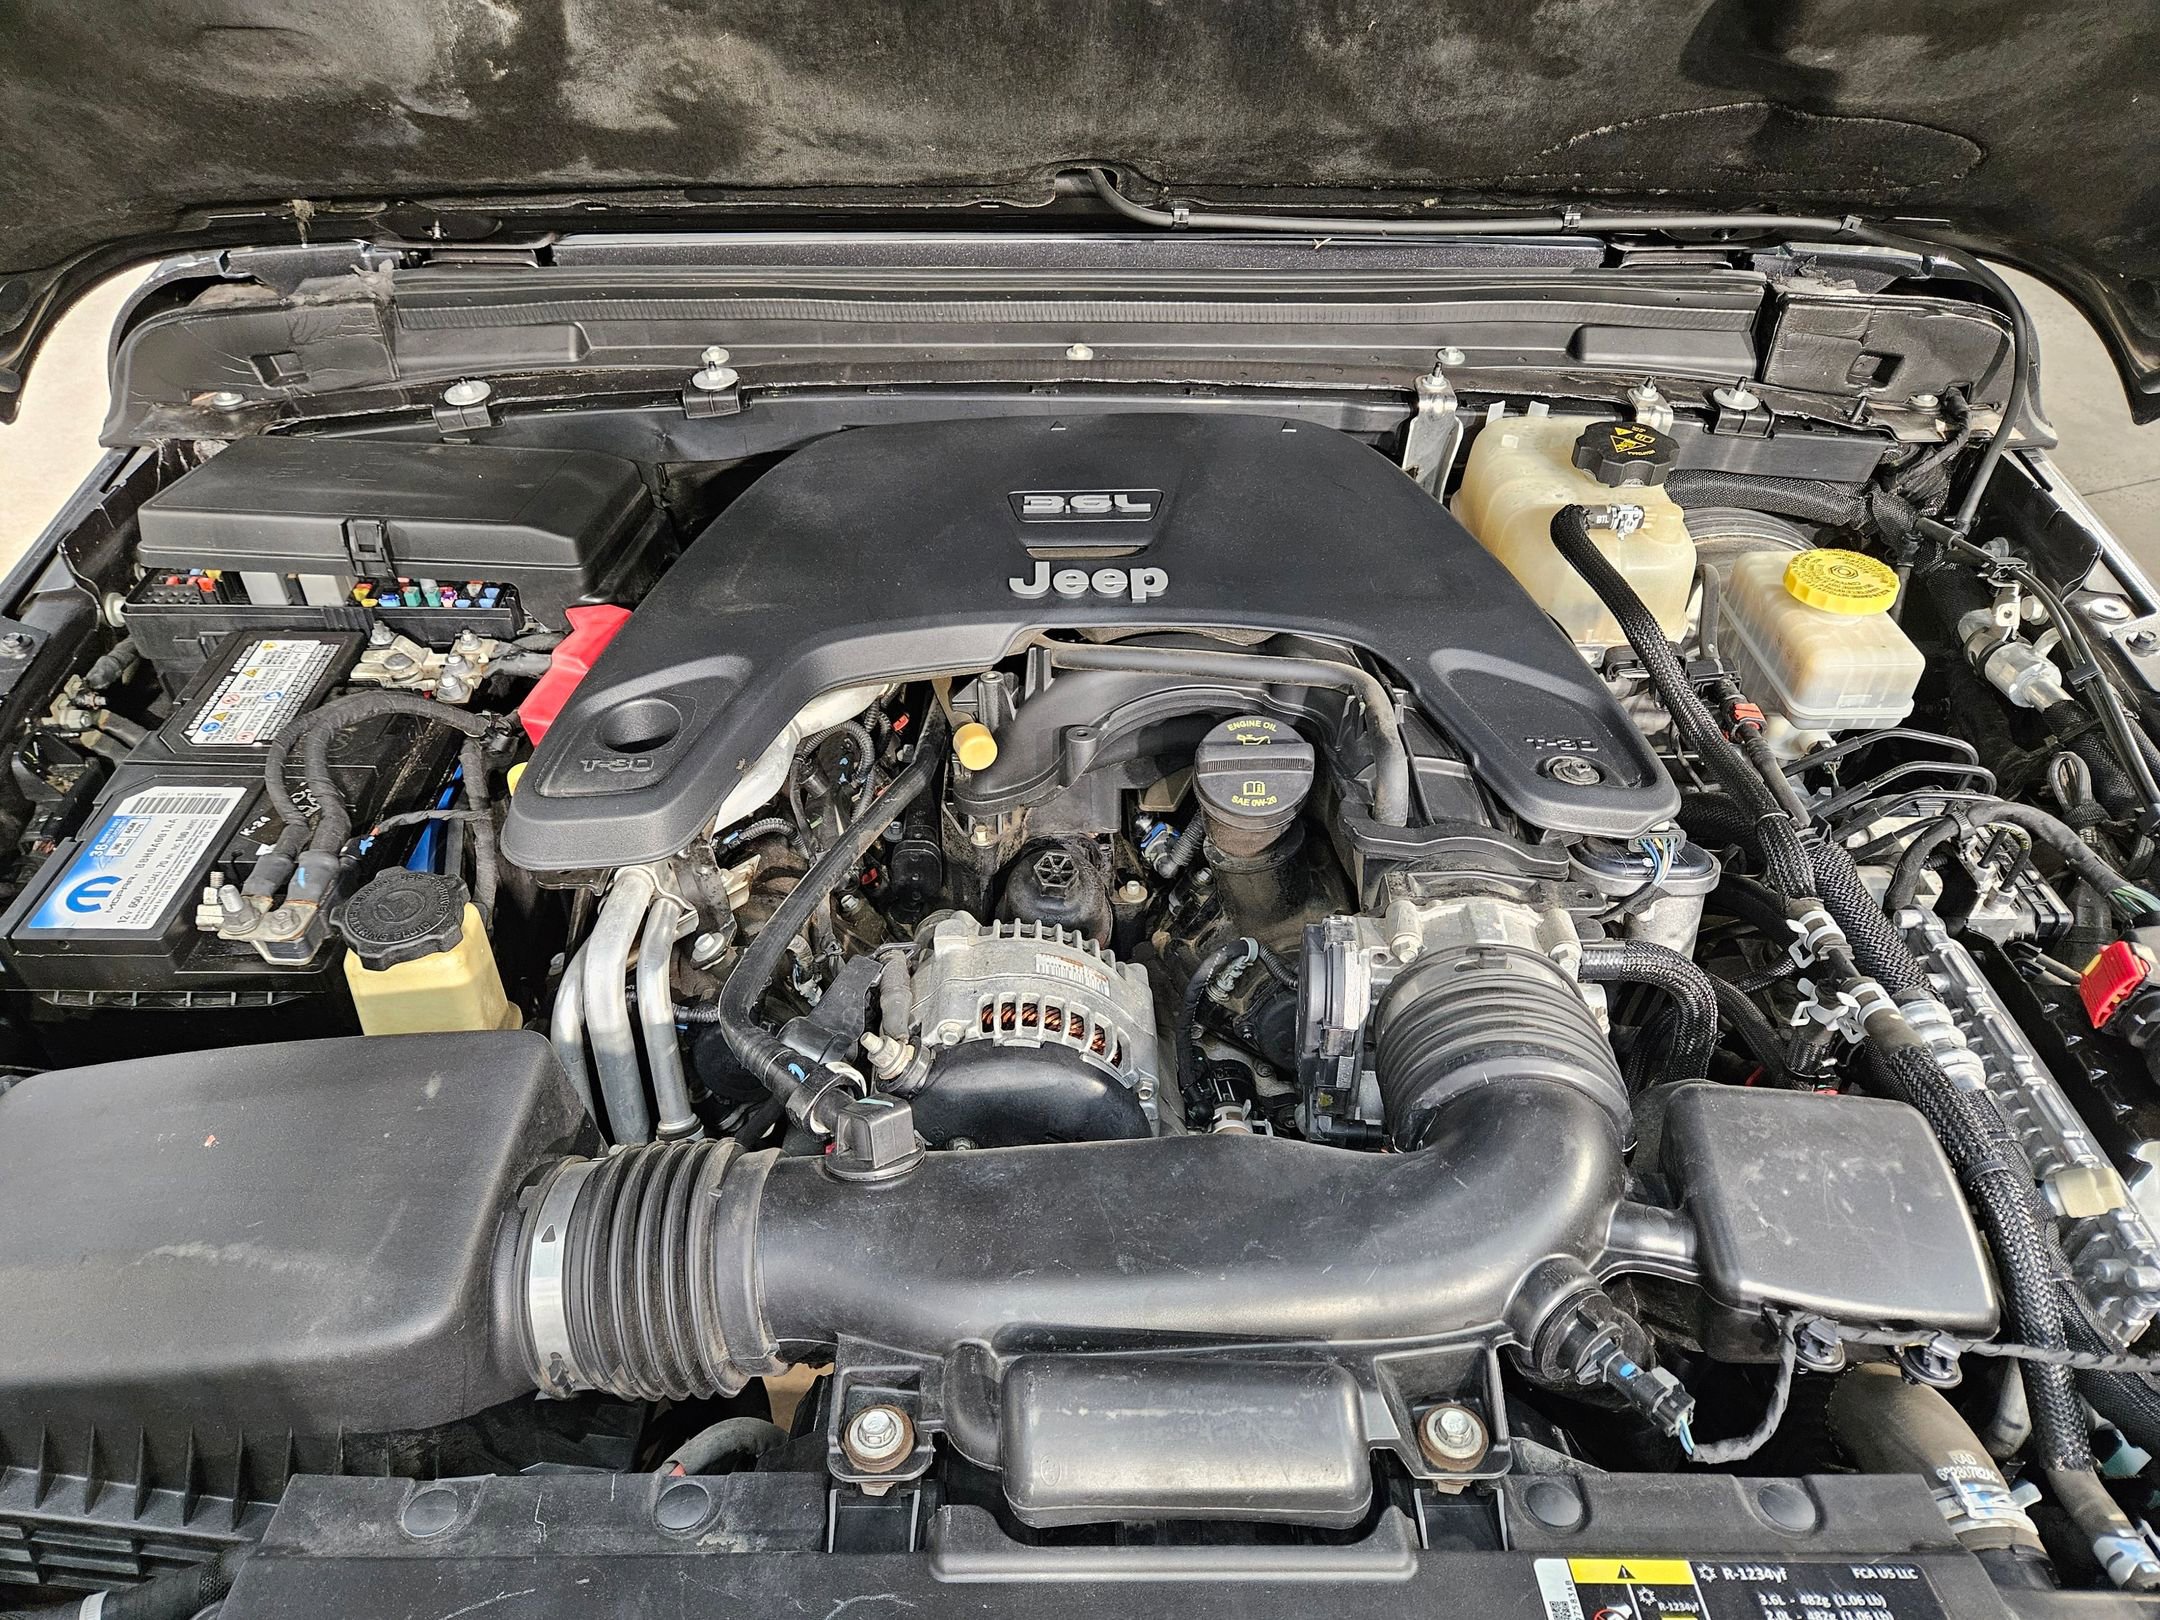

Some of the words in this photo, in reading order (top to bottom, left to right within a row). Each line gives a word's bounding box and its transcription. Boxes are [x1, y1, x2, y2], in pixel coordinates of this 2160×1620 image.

[1022, 494, 1152, 513] 3.6L
[1008, 561, 1170, 604] Jeep
[1226, 719, 1262, 732] ENGINE
[1262, 720, 1278, 732] OIL
[580, 757, 655, 773] T-30
[1231, 795, 1250, 806] SAE
[1250, 795, 1278, 807] 0W-20
[106, 873, 137, 914] MOPAR
[128, 896, 143, 909] 650
[393, 921, 432, 940] FLUID
[1721, 1566, 1788, 1583] R-1234yf
[1851, 1566, 1879, 1579] FCA
[1877, 1566, 1897, 1580] US
[1894, 1566, 1919, 1580] LLC
[1657, 1600, 1700, 1613] R-1234yf
[1759, 1594, 1786, 1606] 3.6L
[1799, 1594, 1832, 1608] 482g
[1832, 1593, 1867, 1608] (1.06
